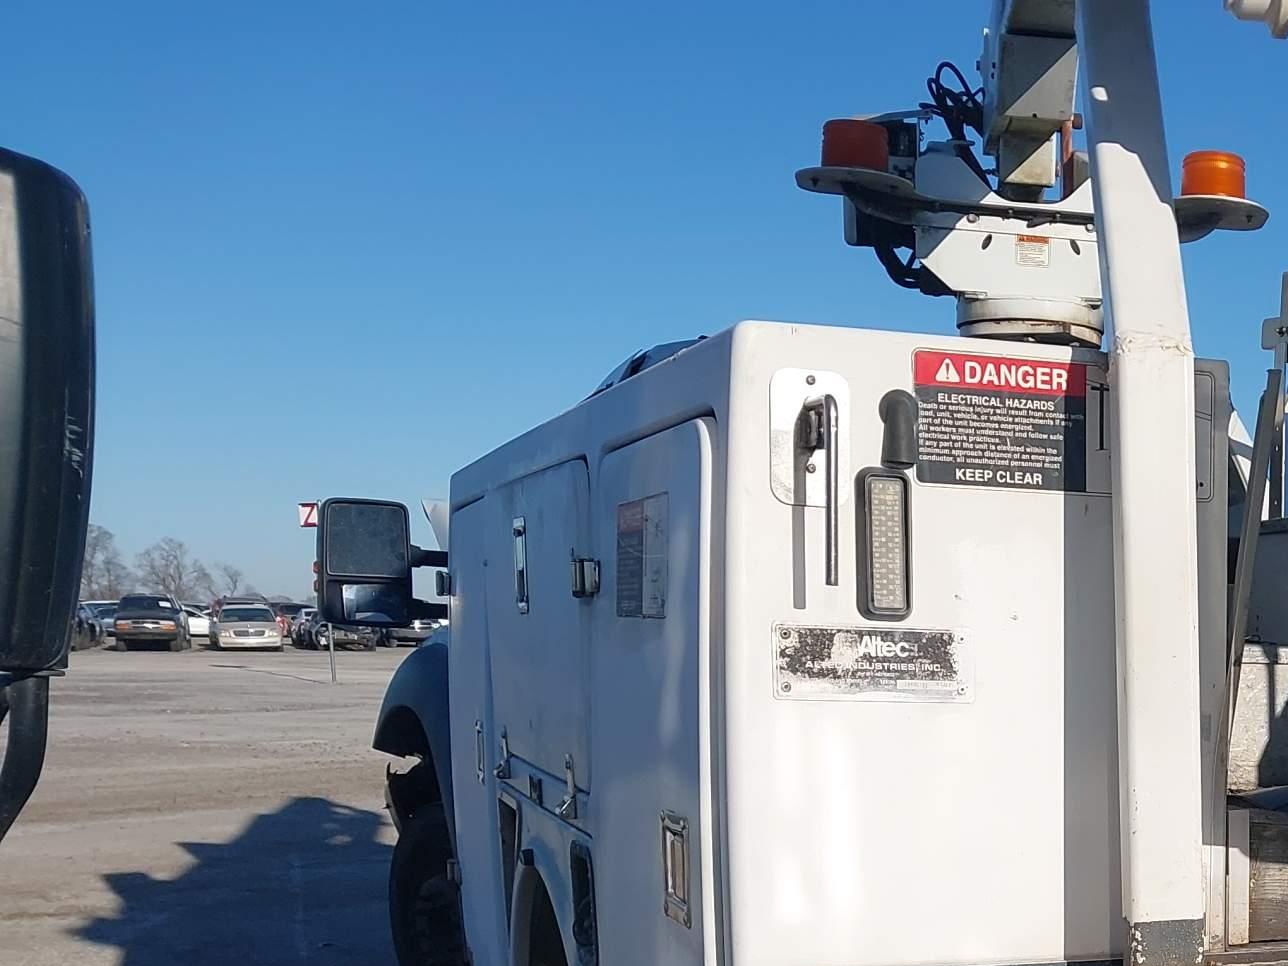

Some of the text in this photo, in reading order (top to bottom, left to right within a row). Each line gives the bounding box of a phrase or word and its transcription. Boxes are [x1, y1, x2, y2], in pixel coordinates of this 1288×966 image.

[964, 360, 1068, 391] DANGER
[918, 401, 938, 409] Death
[974, 406, 993, 414] injury
[937, 392, 1055, 411] ELECTRICAL HAZARDS
[969, 420, 998, 428] becomes
[1000, 423, 1034, 431] energized.
[1014, 417, 1053, 425] attachments
[976, 428, 1013, 436] understand
[952, 449, 982, 457] approach
[984, 450, 1012, 458] distance
[919, 455, 955, 463] conductor,
[966, 458, 1009, 466] unauthorized
[955, 468, 1042, 485] KEEP CLEAR
[859, 635, 910, 657] Altec
